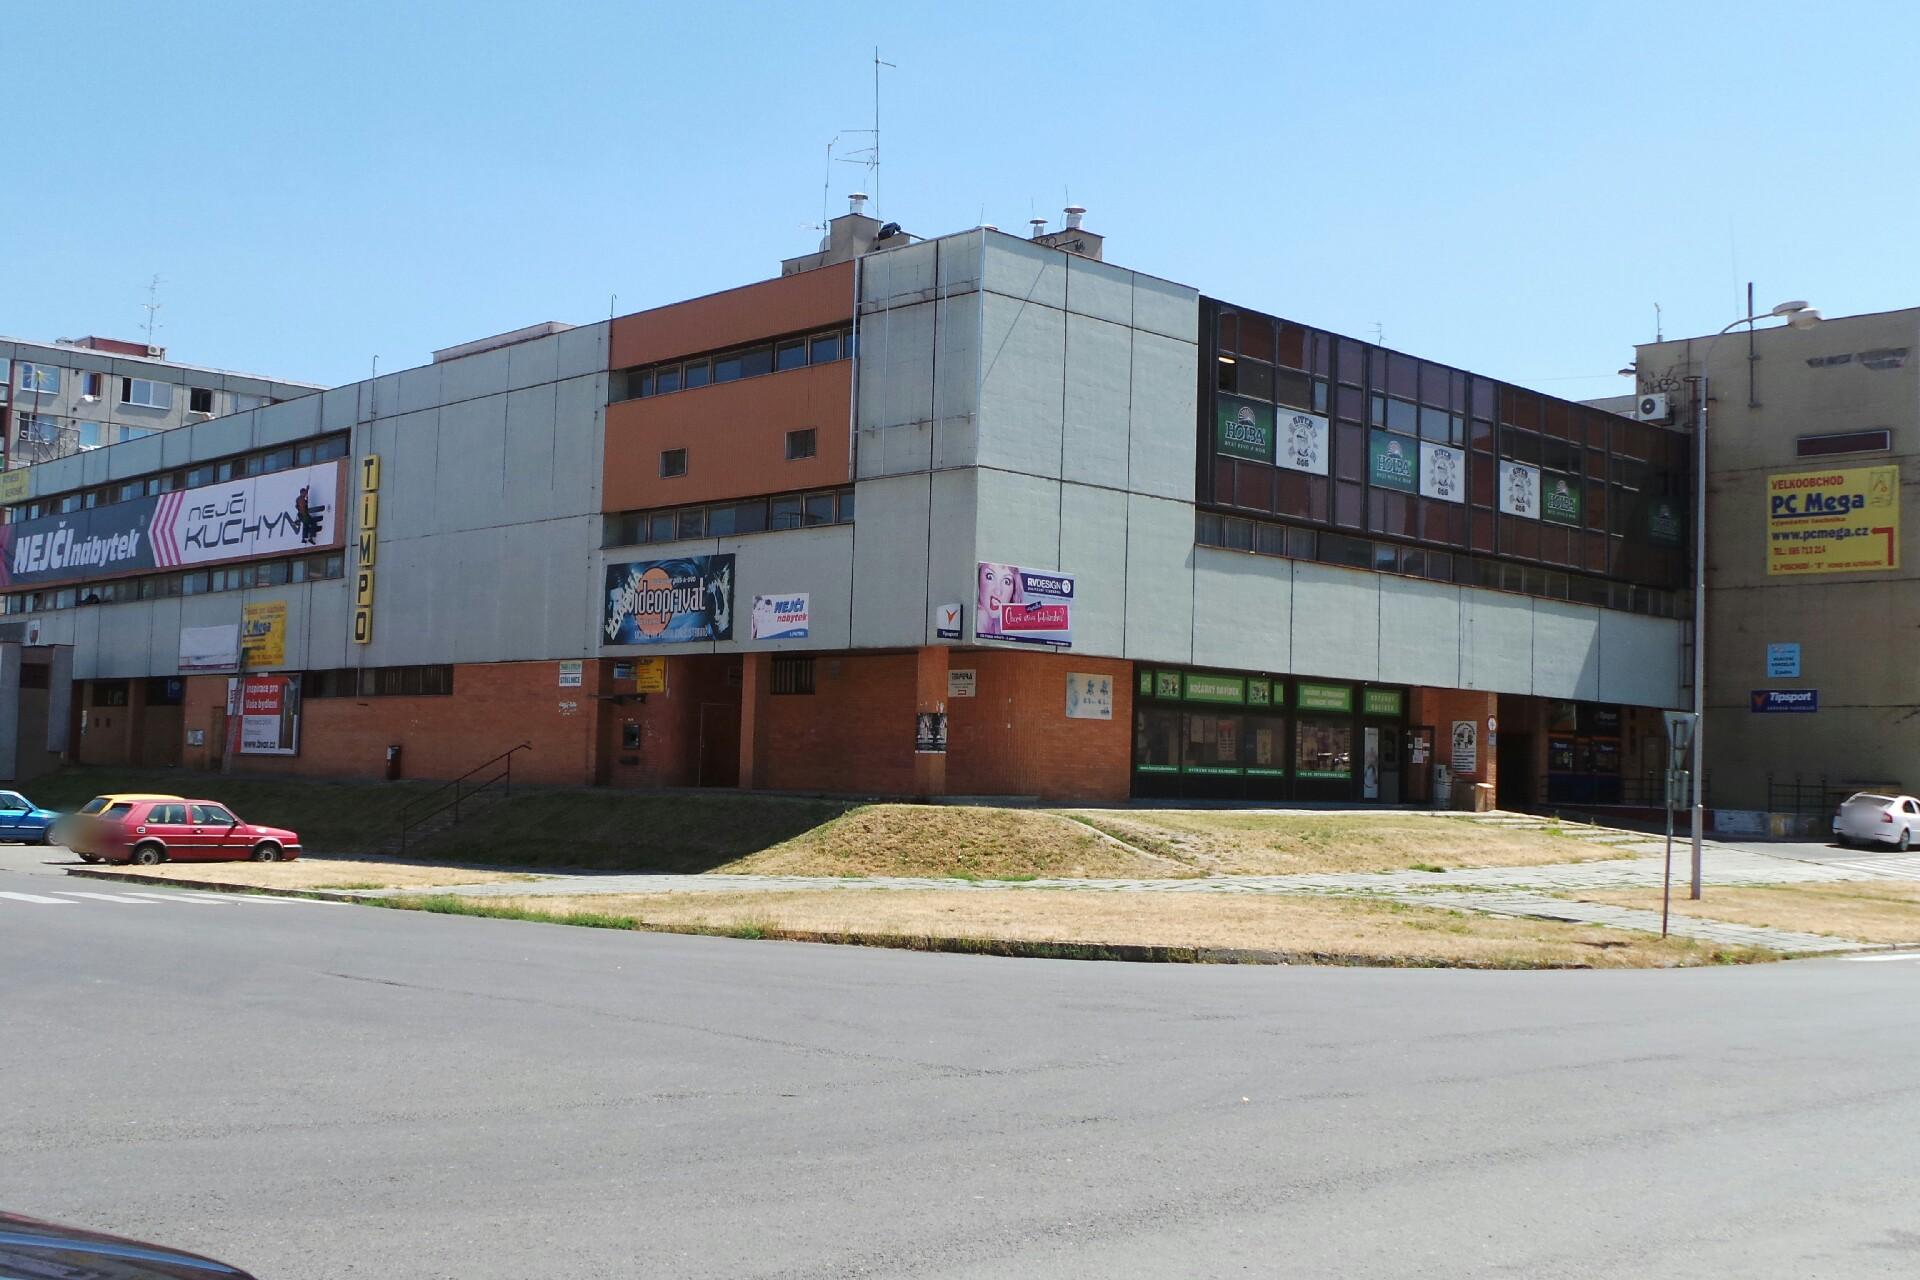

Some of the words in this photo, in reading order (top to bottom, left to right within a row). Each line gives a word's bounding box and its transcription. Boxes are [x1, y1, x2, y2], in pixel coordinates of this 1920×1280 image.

[1225, 421, 1266, 446] HOLBA
[1376, 454, 1412, 478] HOLBA
[1771, 475, 1845, 490] VELKOOBCHOD
[1547, 492, 1577, 513] HOLBA
[1771, 494, 1799, 516] PC
[1804, 492, 1865, 514] Mega
[1771, 526, 1869, 542] www.pcmega.cz
[1027, 577, 1062, 590] RVDESIGN
[773, 597, 805, 614] NEJČI
[1769, 691, 1812, 703] Tipsport
